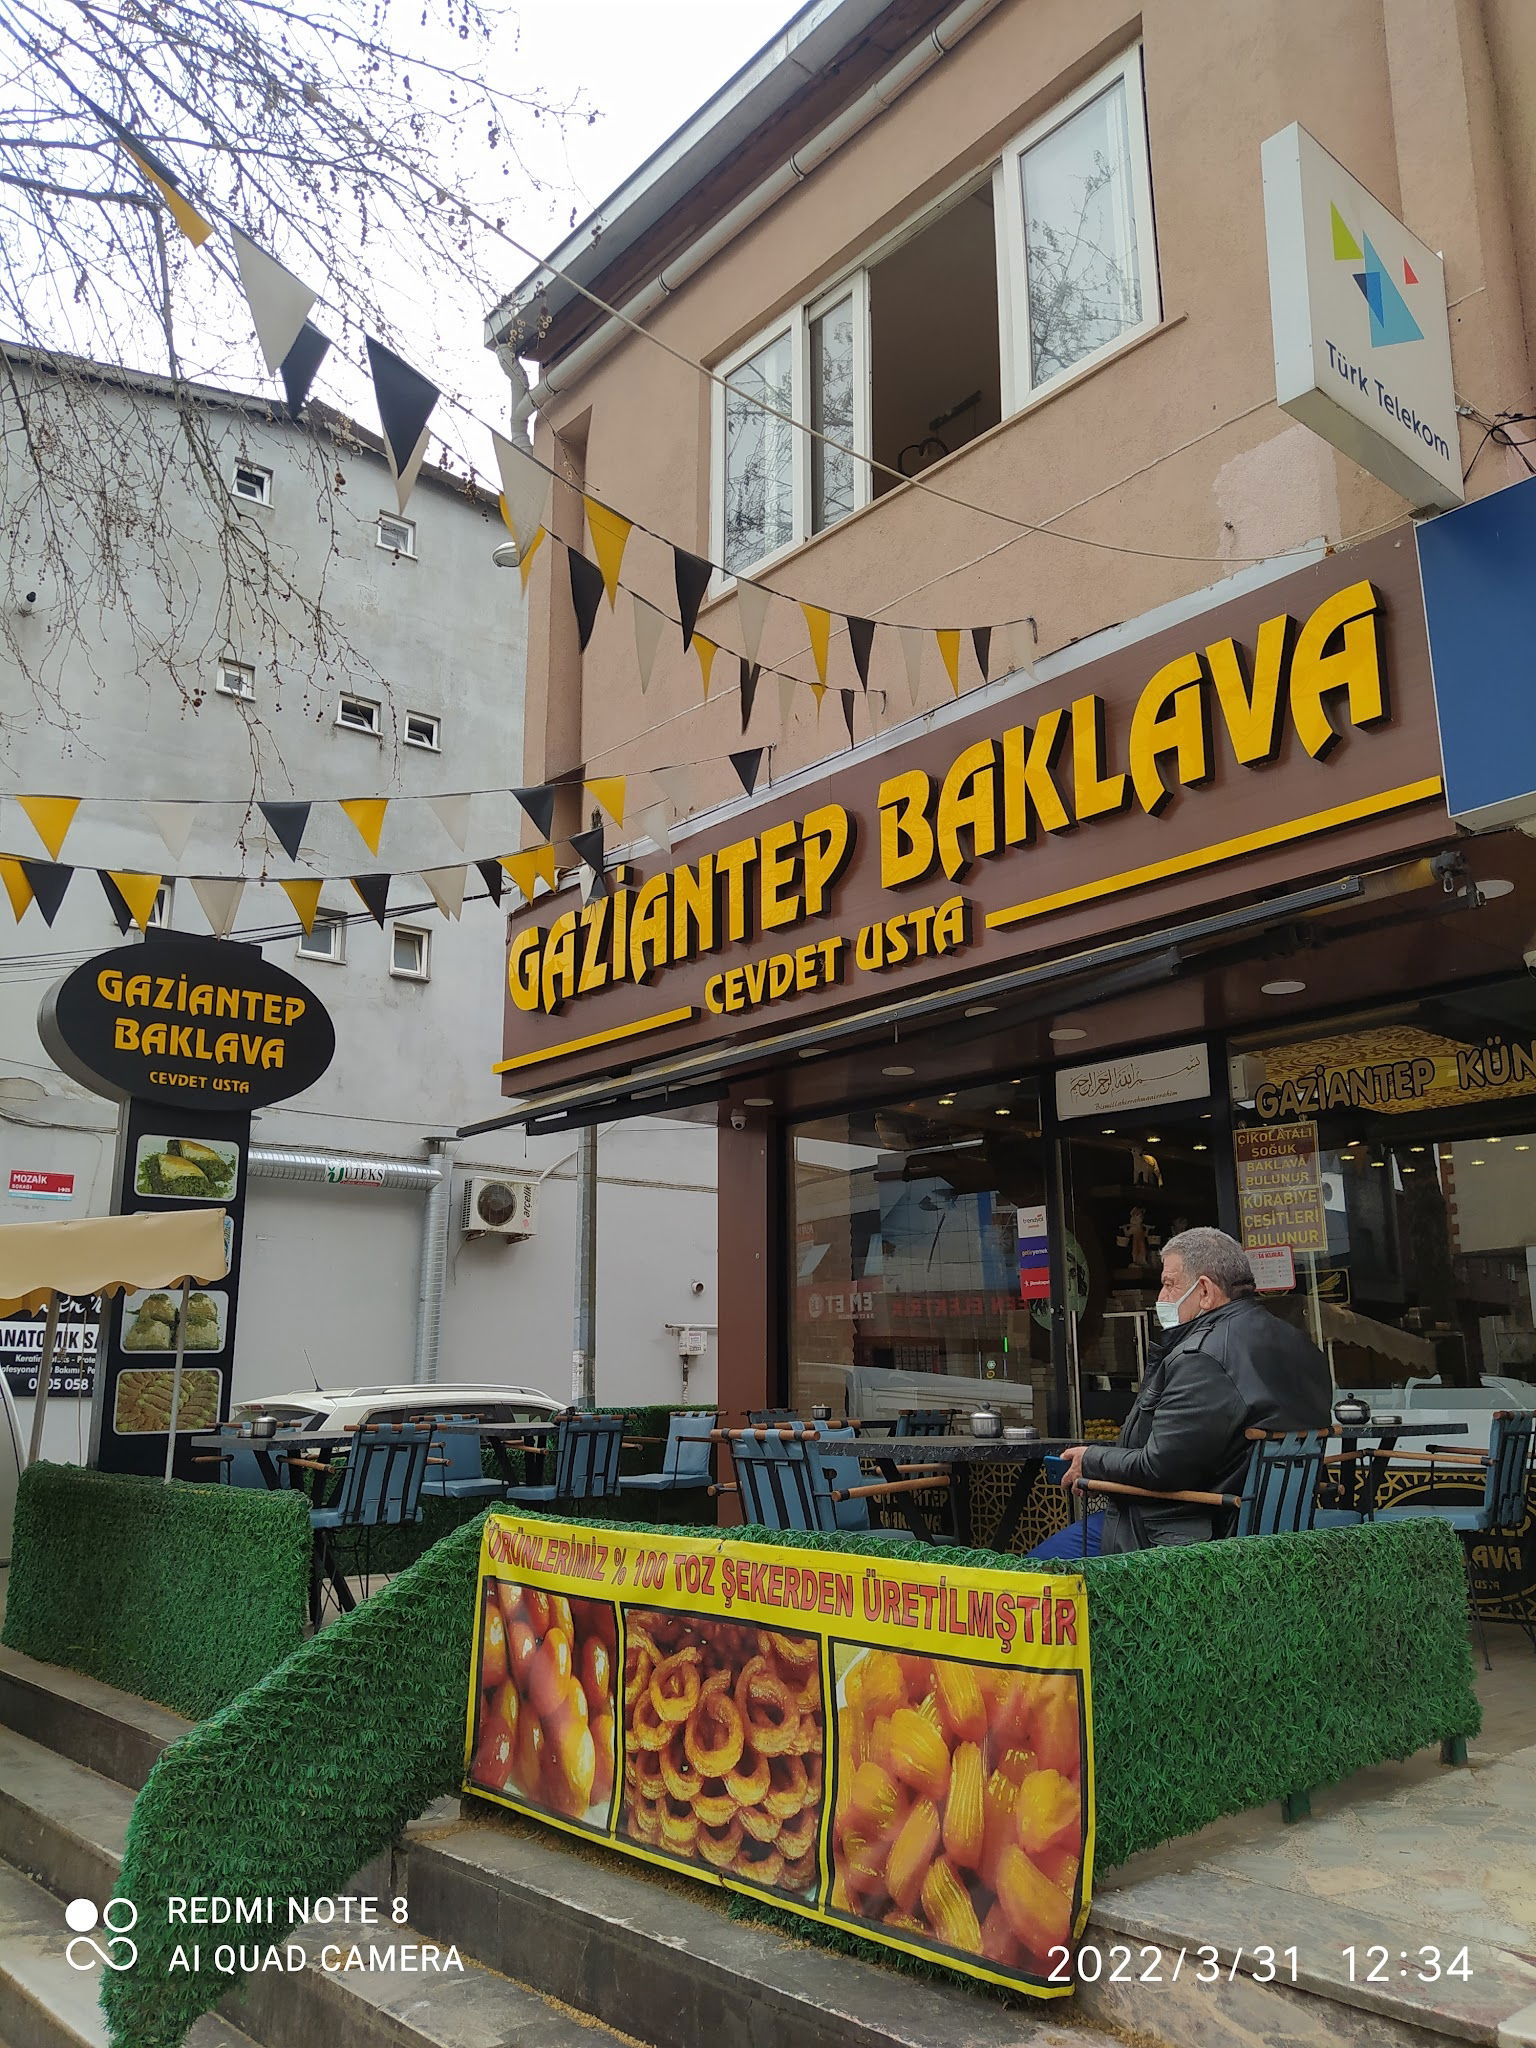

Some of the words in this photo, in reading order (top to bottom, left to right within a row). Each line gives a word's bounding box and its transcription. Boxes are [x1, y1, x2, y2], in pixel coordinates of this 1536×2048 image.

[1325, 339, 1369, 398] Türk
[1374, 379, 1450, 461] Telekom
[508, 803, 852, 1015] GAZİANTEP
[876, 579, 1386, 889] BAKLAVA
[704, 937, 843, 1015] CEVDET
[855, 896, 966, 971] USTA
[96, 969, 306, 1026] GAZİANTEP
[114, 1017, 285, 1070] BAKLAVA
[149, 1071, 208, 1090] CEVDET
[212, 1078, 250, 1094] USTA
[1255, 1057, 1436, 1119] GAZİANTEP
[1247, 1157, 1307, 1173] BAKLAVA
[1251, 1143, 1297, 1158] SOĞUK
[13, 1174, 48, 1185] MOZAİK
[1245, 1171, 1309, 1186] BULUNUR
[1244, 1207, 1320, 1232] ÇEŞİTLERİ
[1247, 1230, 1319, 1249] BULUNUR
[488, 1523, 609, 1582] ÜRÜNLERİMİZ
[633, 1549, 669, 1590] 100
[673, 1554, 715, 1596] TOZ
[721, 1557, 854, 1618] ŞEKERDEN
[862, 1568, 1078, 1653] ÜRETİLMŞTİR
